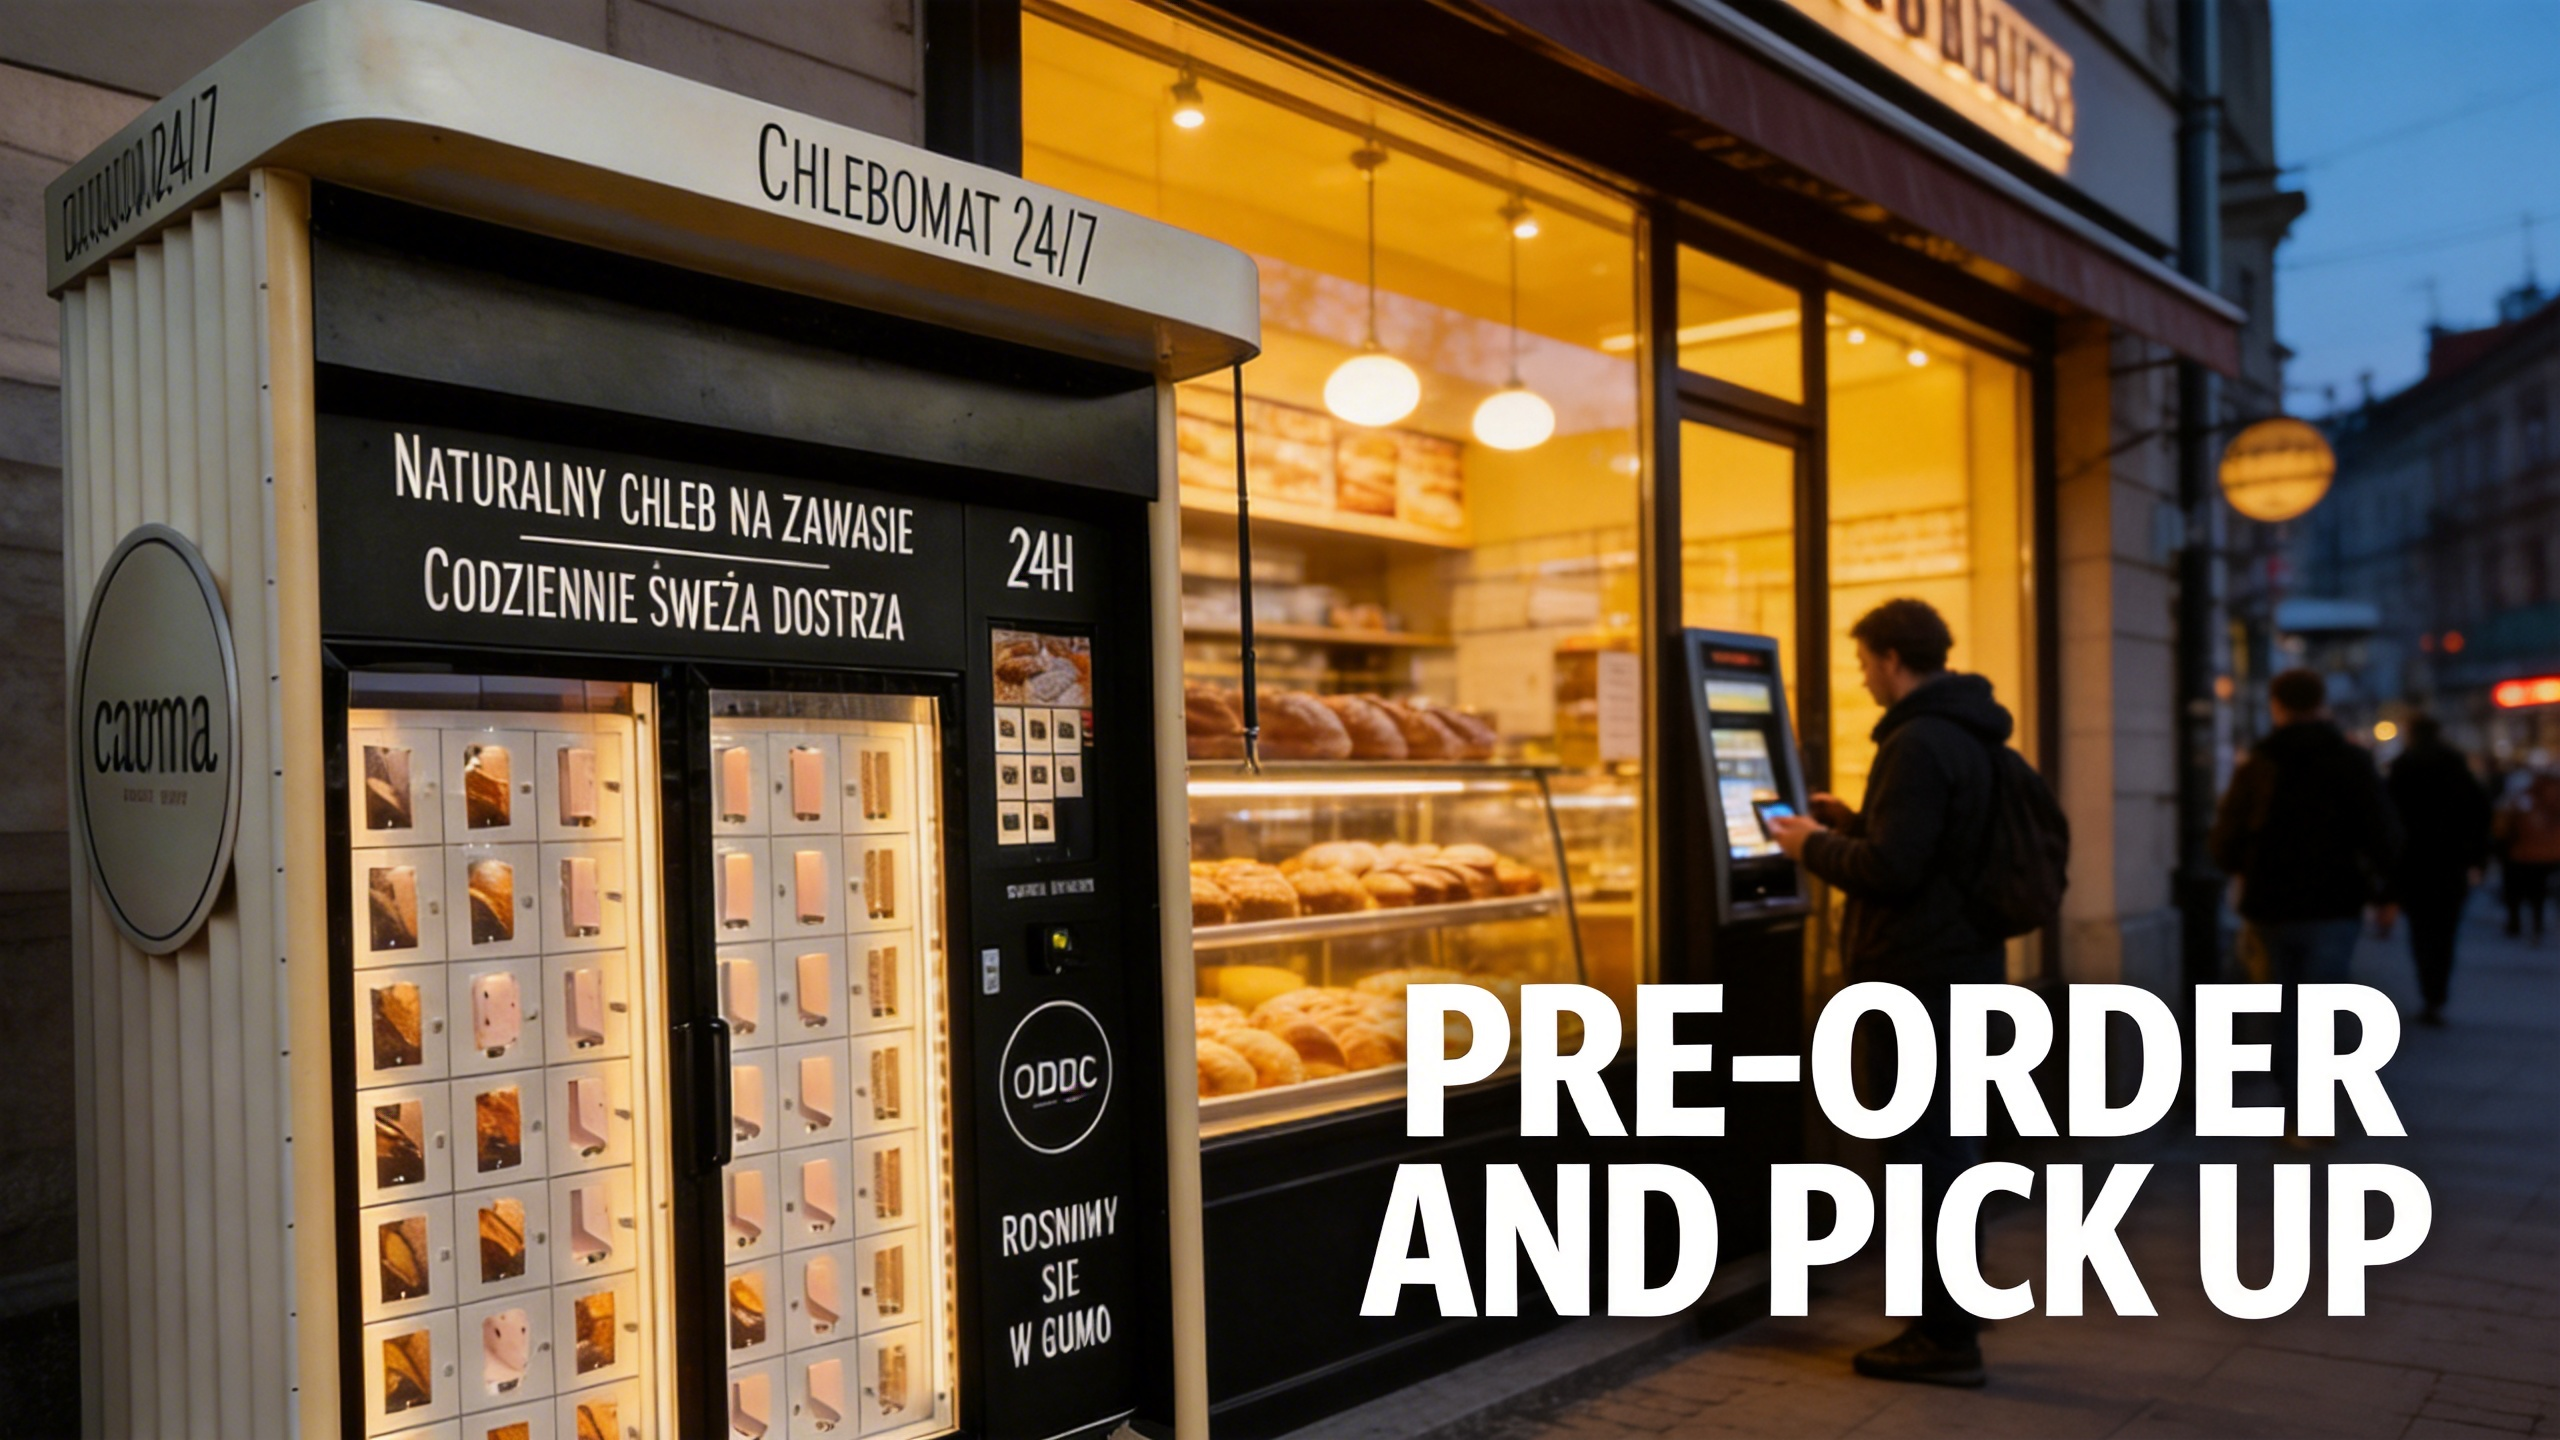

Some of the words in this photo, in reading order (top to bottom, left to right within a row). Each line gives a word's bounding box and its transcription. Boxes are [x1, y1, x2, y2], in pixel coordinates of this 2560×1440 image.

[758, 122, 1001, 257] CHLEBOMAT
[1012, 196, 1098, 286] 24/7
[394, 432, 607, 520] NATURALNY
[620, 472, 716, 532] CHLEB
[730, 486, 773, 539] NA
[781, 493, 914, 555] ZAWASIE
[1007, 526, 1073, 592] 24H
[424, 546, 639, 625] CODZIENNIE
[772, 585, 905, 641] DOSTRZA
[1013, 1055, 1098, 1099] ODDC
[1041, 1258, 1081, 1304] SIE
[1009, 1321, 1032, 1368] W
[1041, 1304, 1112, 1358] GUMO
